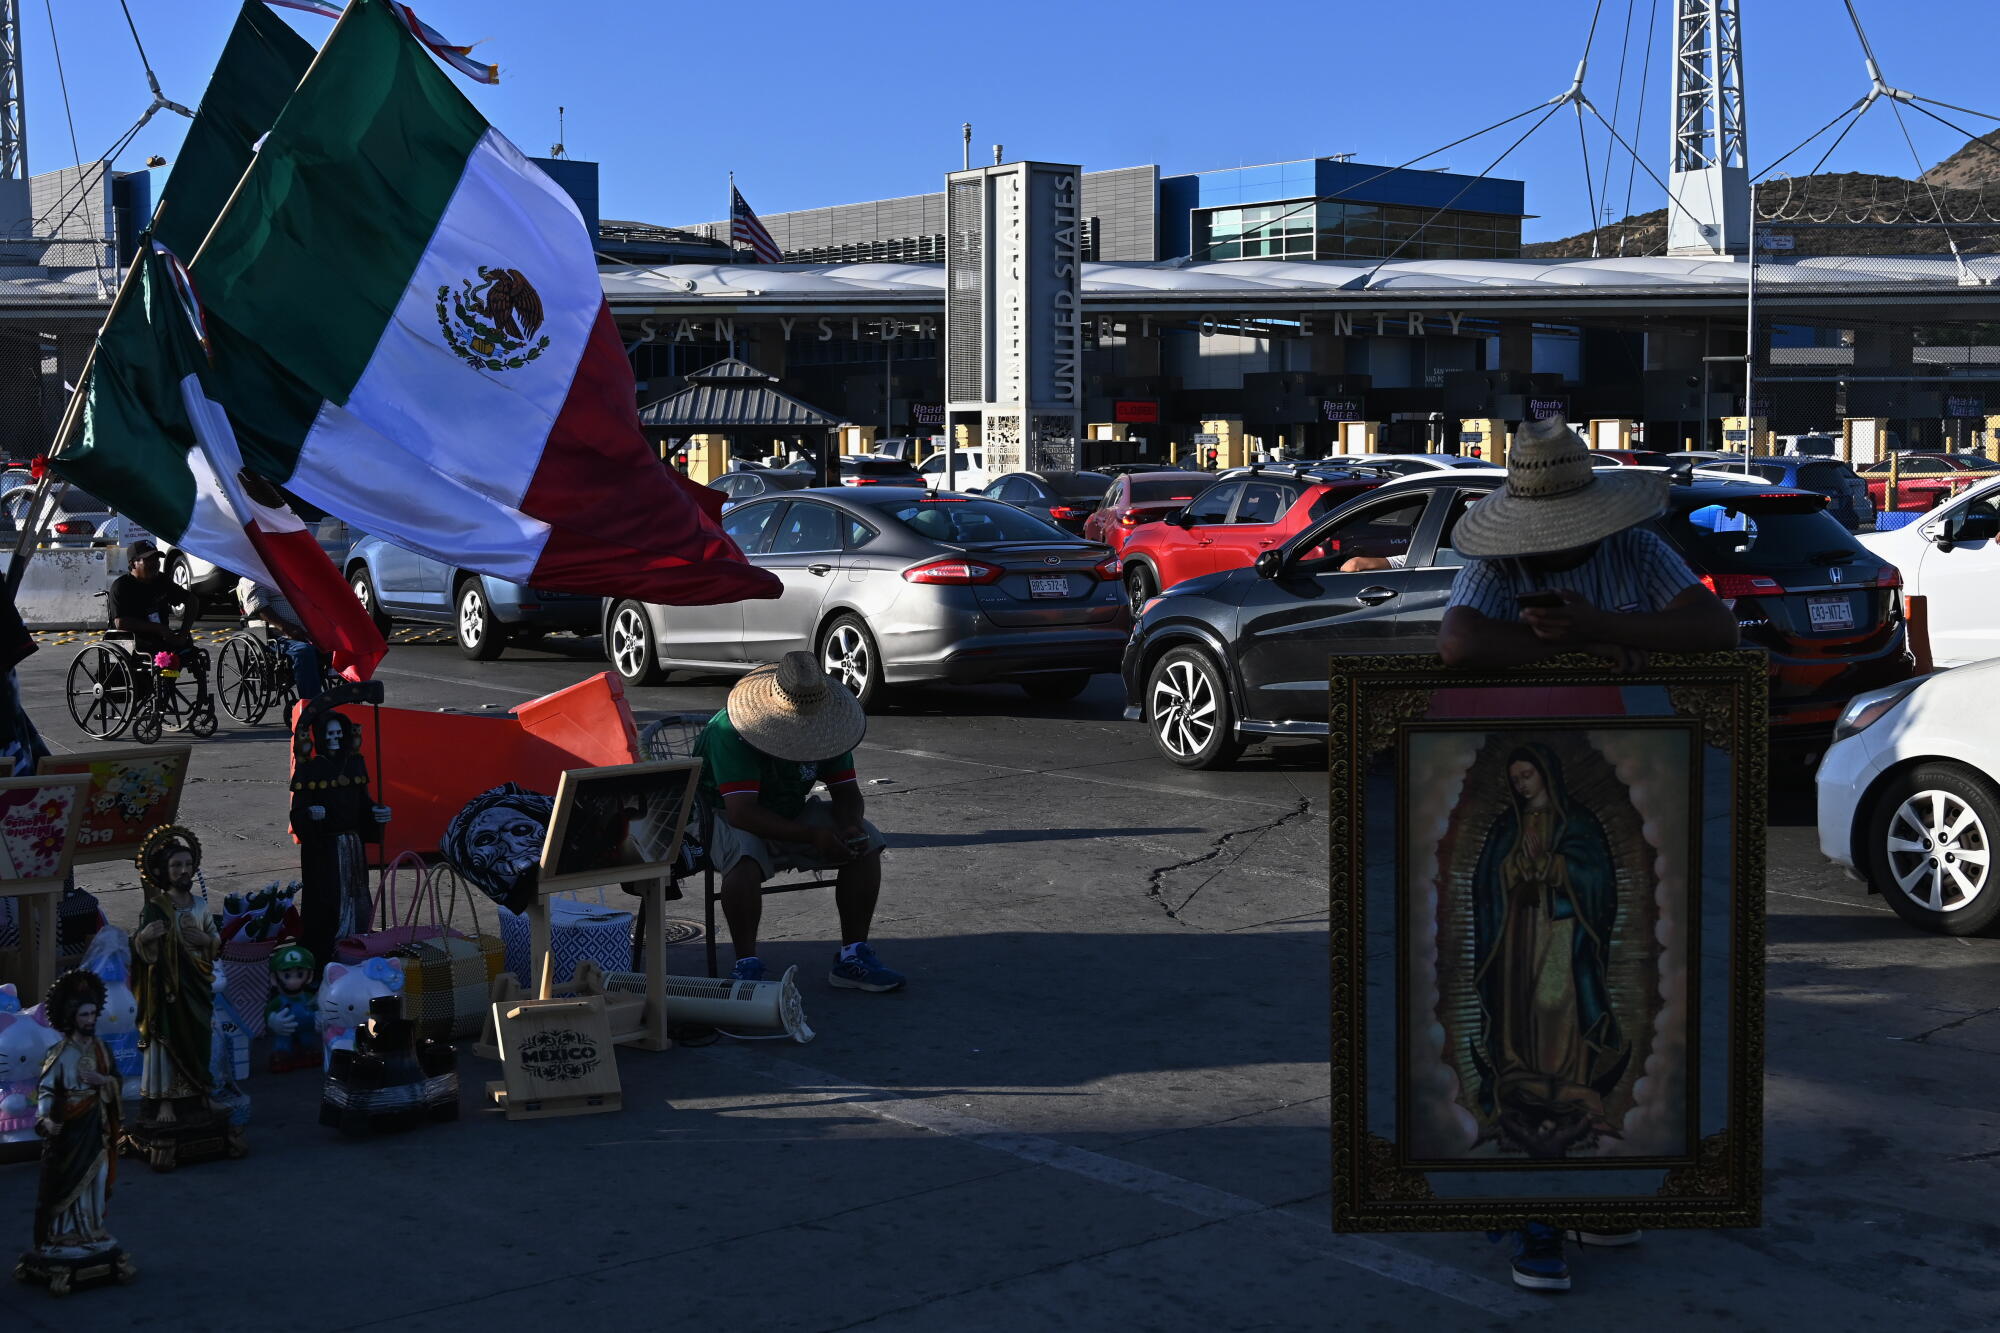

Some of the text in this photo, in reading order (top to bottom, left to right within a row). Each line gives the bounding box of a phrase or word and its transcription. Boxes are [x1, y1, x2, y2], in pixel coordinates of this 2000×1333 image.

[1054, 175, 1075, 279] STATES
[640, 311, 1465, 342] SAN YSIDR RT OF ENTRY
[1054, 290, 1075, 401] UNITED
[1323, 401, 1357, 414] Ready
[1530, 400, 1563, 413] Ready
[290, 953, 298, 961] L
